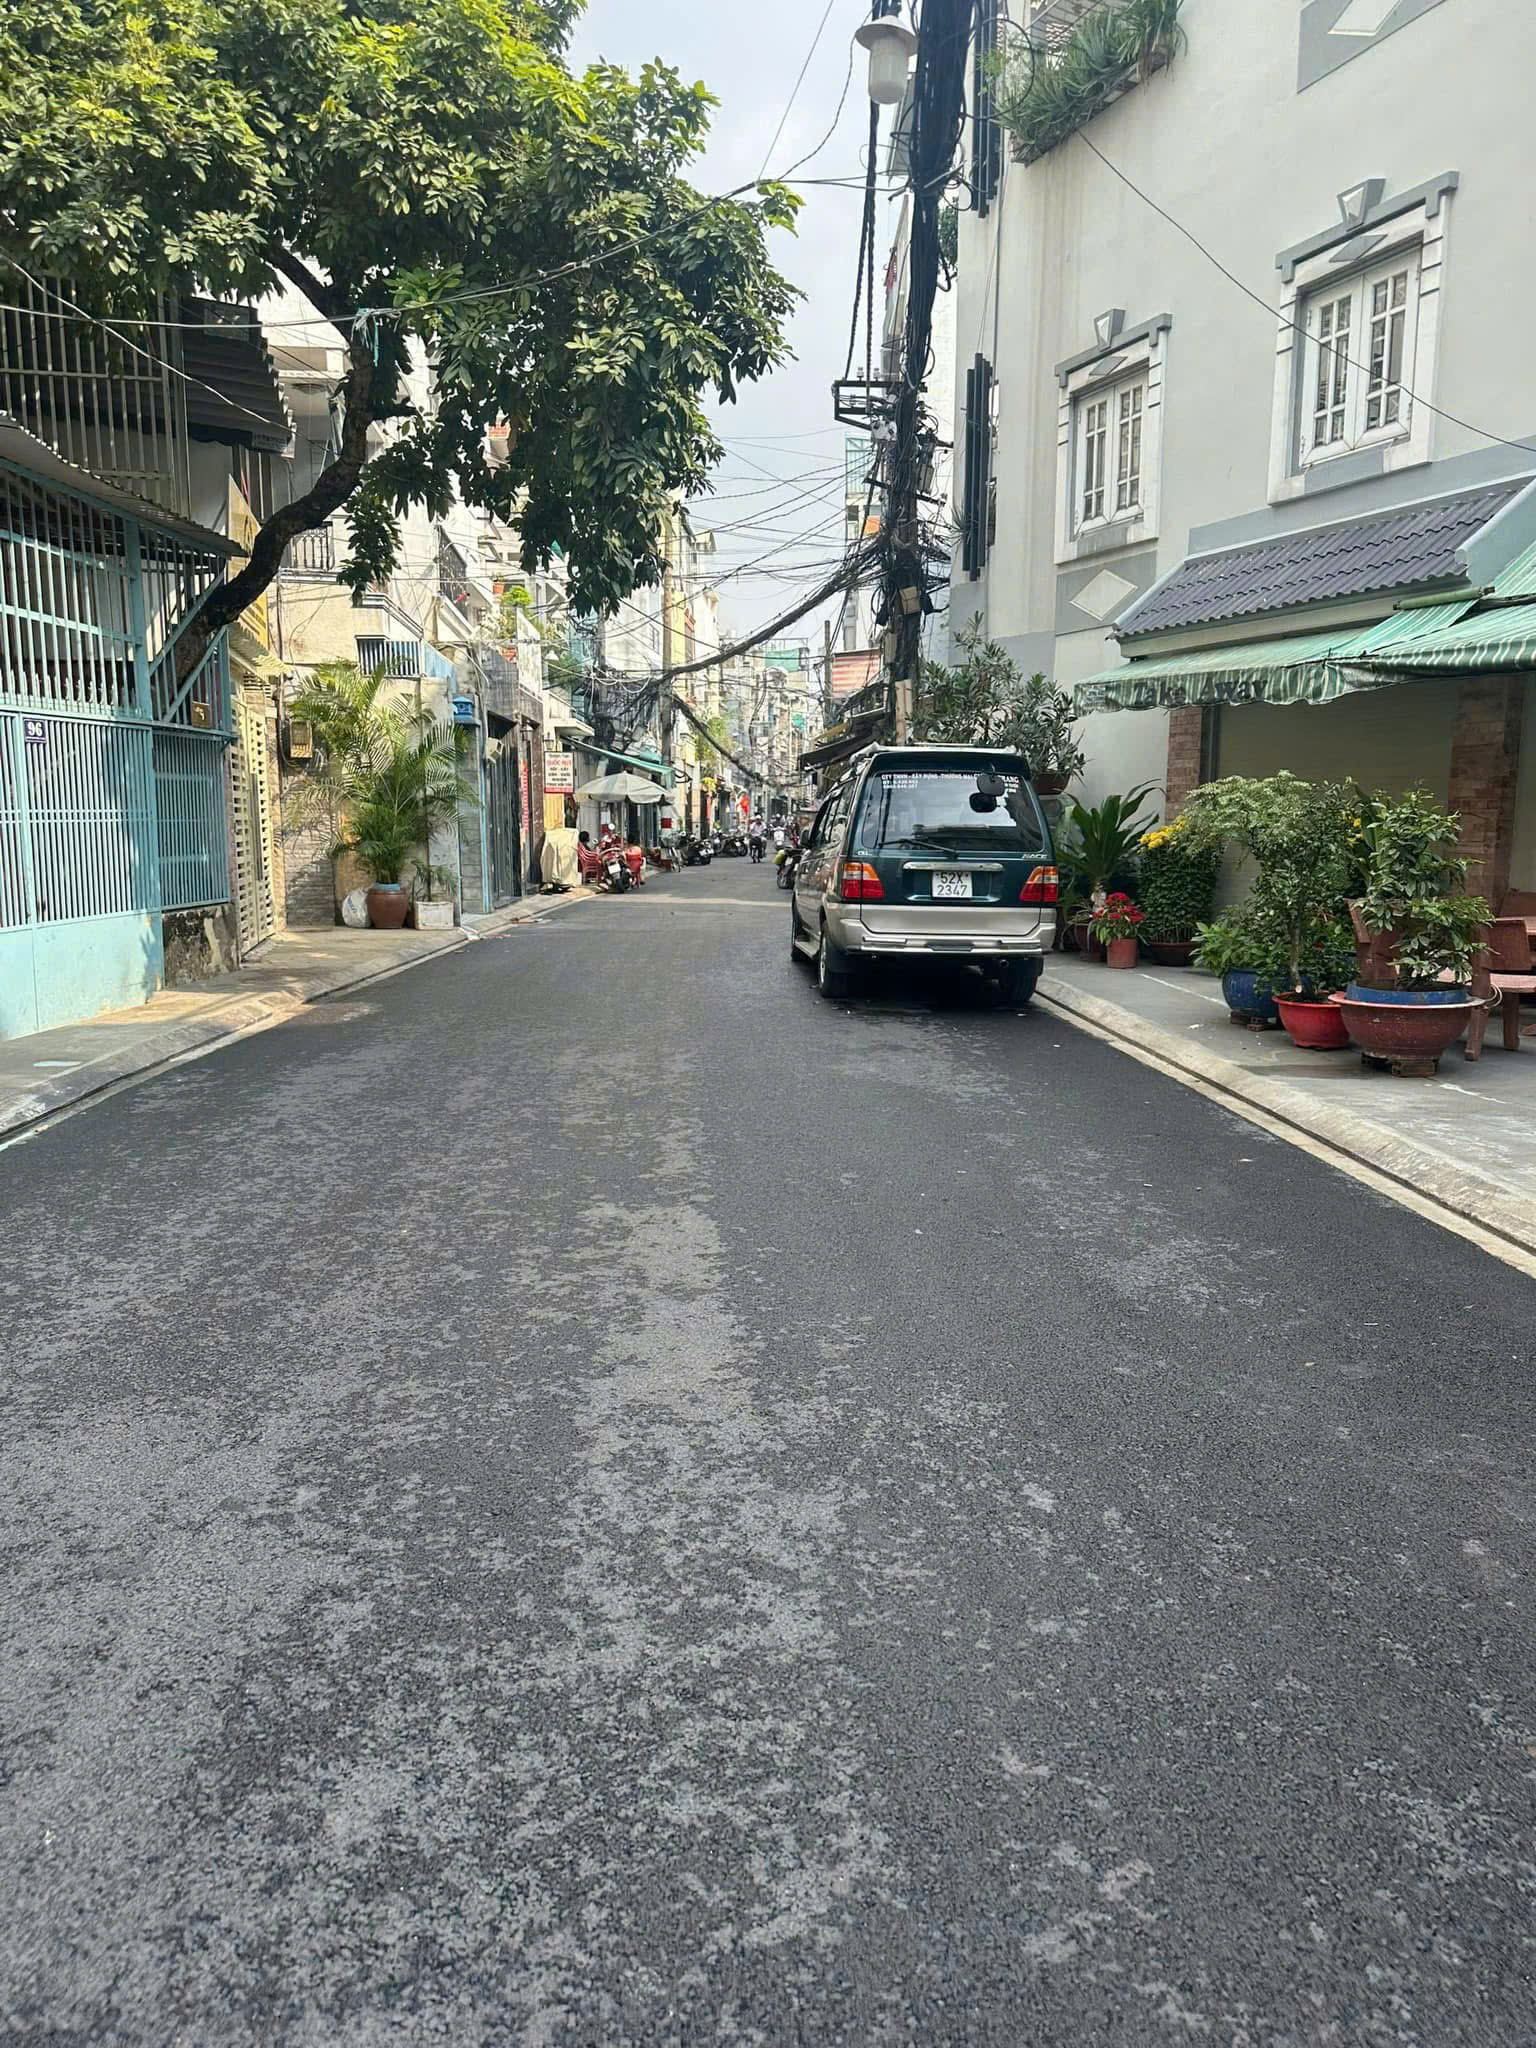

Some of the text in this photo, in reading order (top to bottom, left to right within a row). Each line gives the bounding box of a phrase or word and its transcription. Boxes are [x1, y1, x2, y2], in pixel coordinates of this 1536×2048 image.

[1134, 681, 1185, 706] Take
[1200, 674, 1267, 704] Away
[27, 722, 43, 737] 96
[940, 871, 964, 884] 52X
[937, 885, 968, 897] 2347
